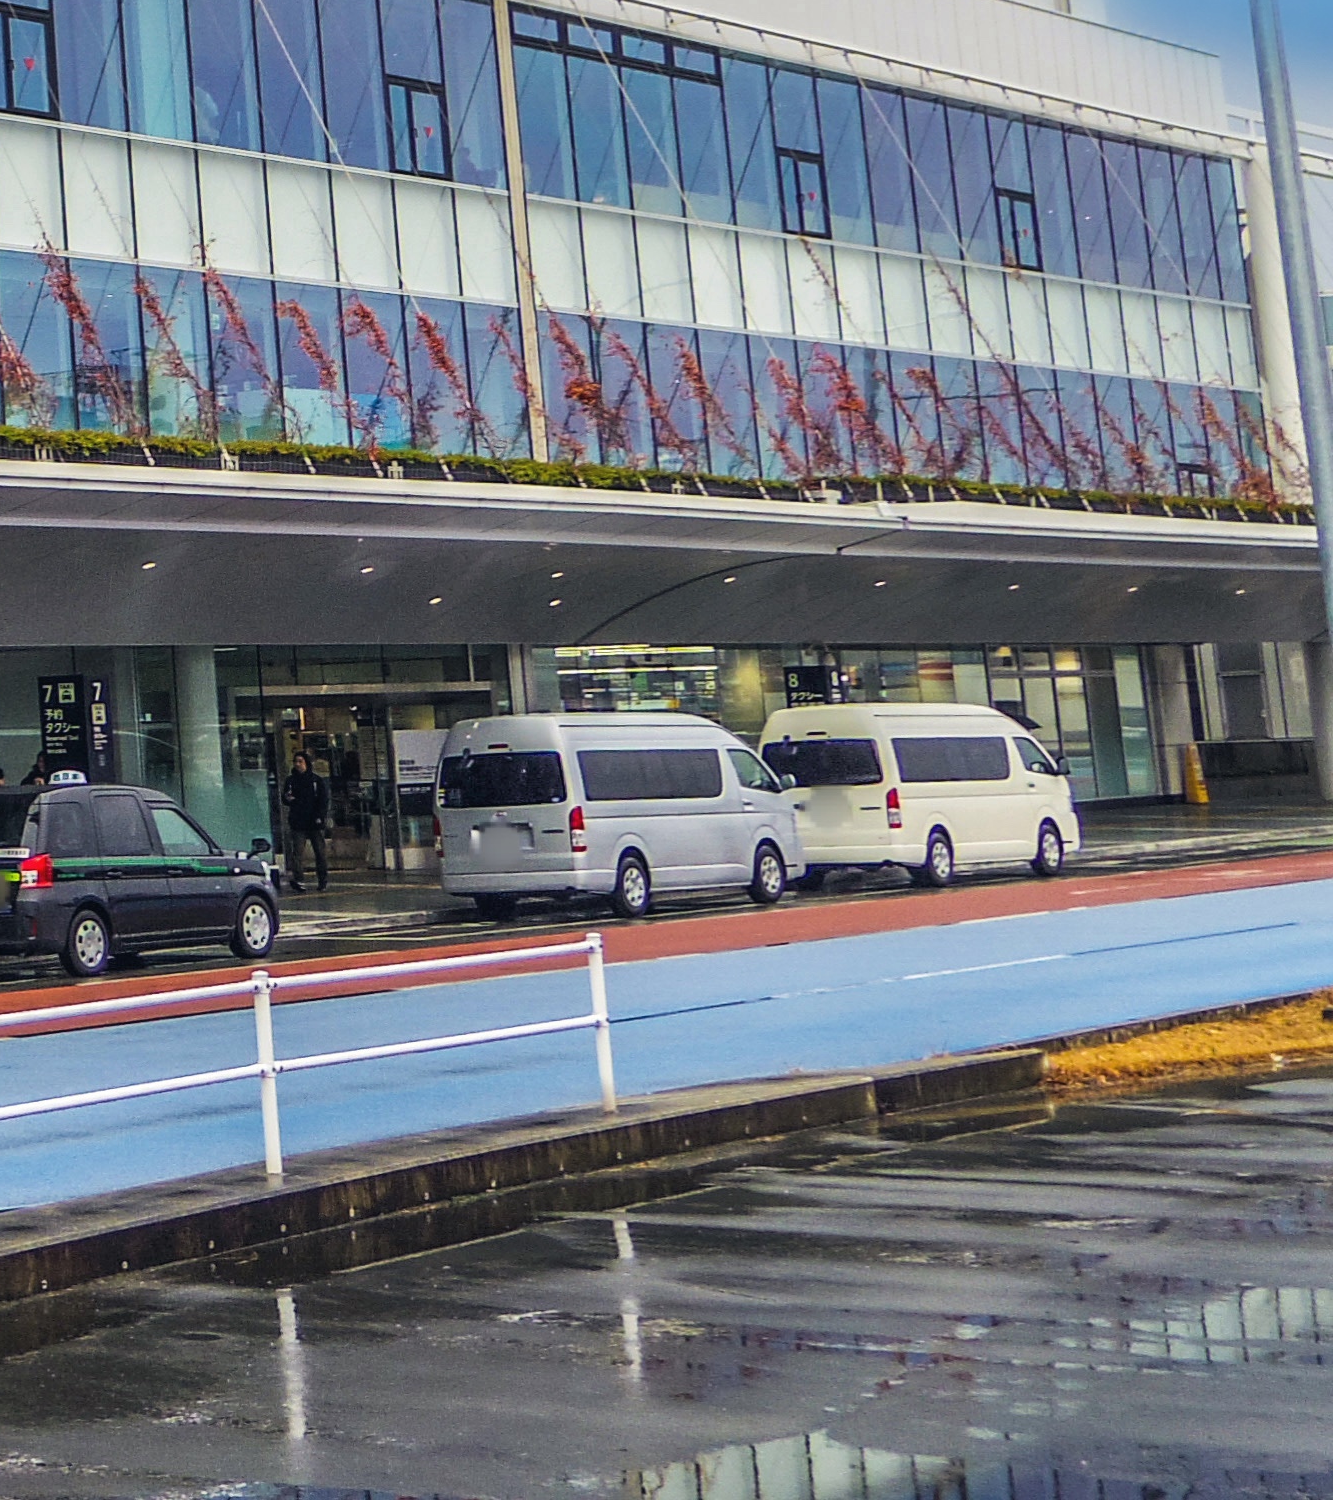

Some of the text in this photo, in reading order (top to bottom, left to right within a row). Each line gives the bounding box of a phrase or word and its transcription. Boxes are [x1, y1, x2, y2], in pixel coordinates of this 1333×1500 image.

[788, 673, 799, 688] 8
[42, 684, 52, 703] 7
[93, 682, 101, 701] 7
[45, 722, 80, 733] タクシー
